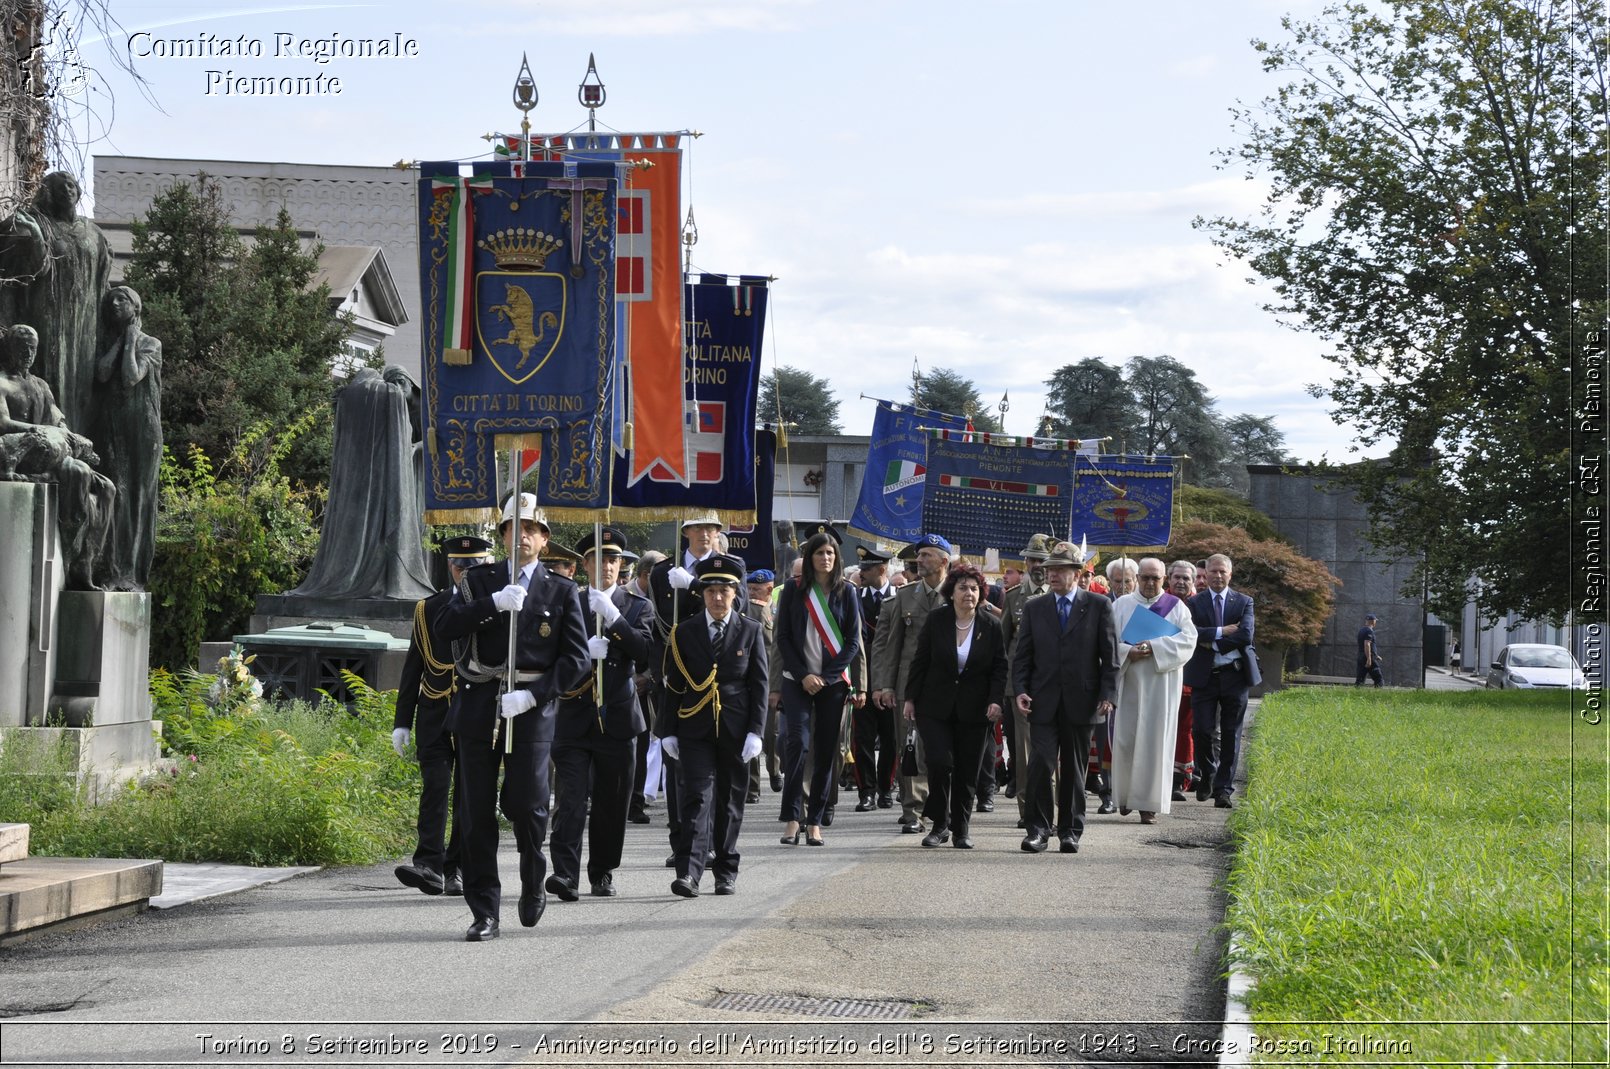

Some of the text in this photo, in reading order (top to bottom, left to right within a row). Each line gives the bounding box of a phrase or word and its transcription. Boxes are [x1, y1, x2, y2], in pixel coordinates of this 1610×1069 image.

[685, 319, 712, 339] TTÀ
[685, 345, 752, 363] POLITANA
[685, 368, 727, 385] ORINO
[506, 394, 520, 411] DI
[525, 395, 583, 412] TORINO
[979, 462, 1023, 474] PIEMONTE
[861, 504, 922, 536] SEZIONE DI TOR
[729, 537, 749, 549] INO
